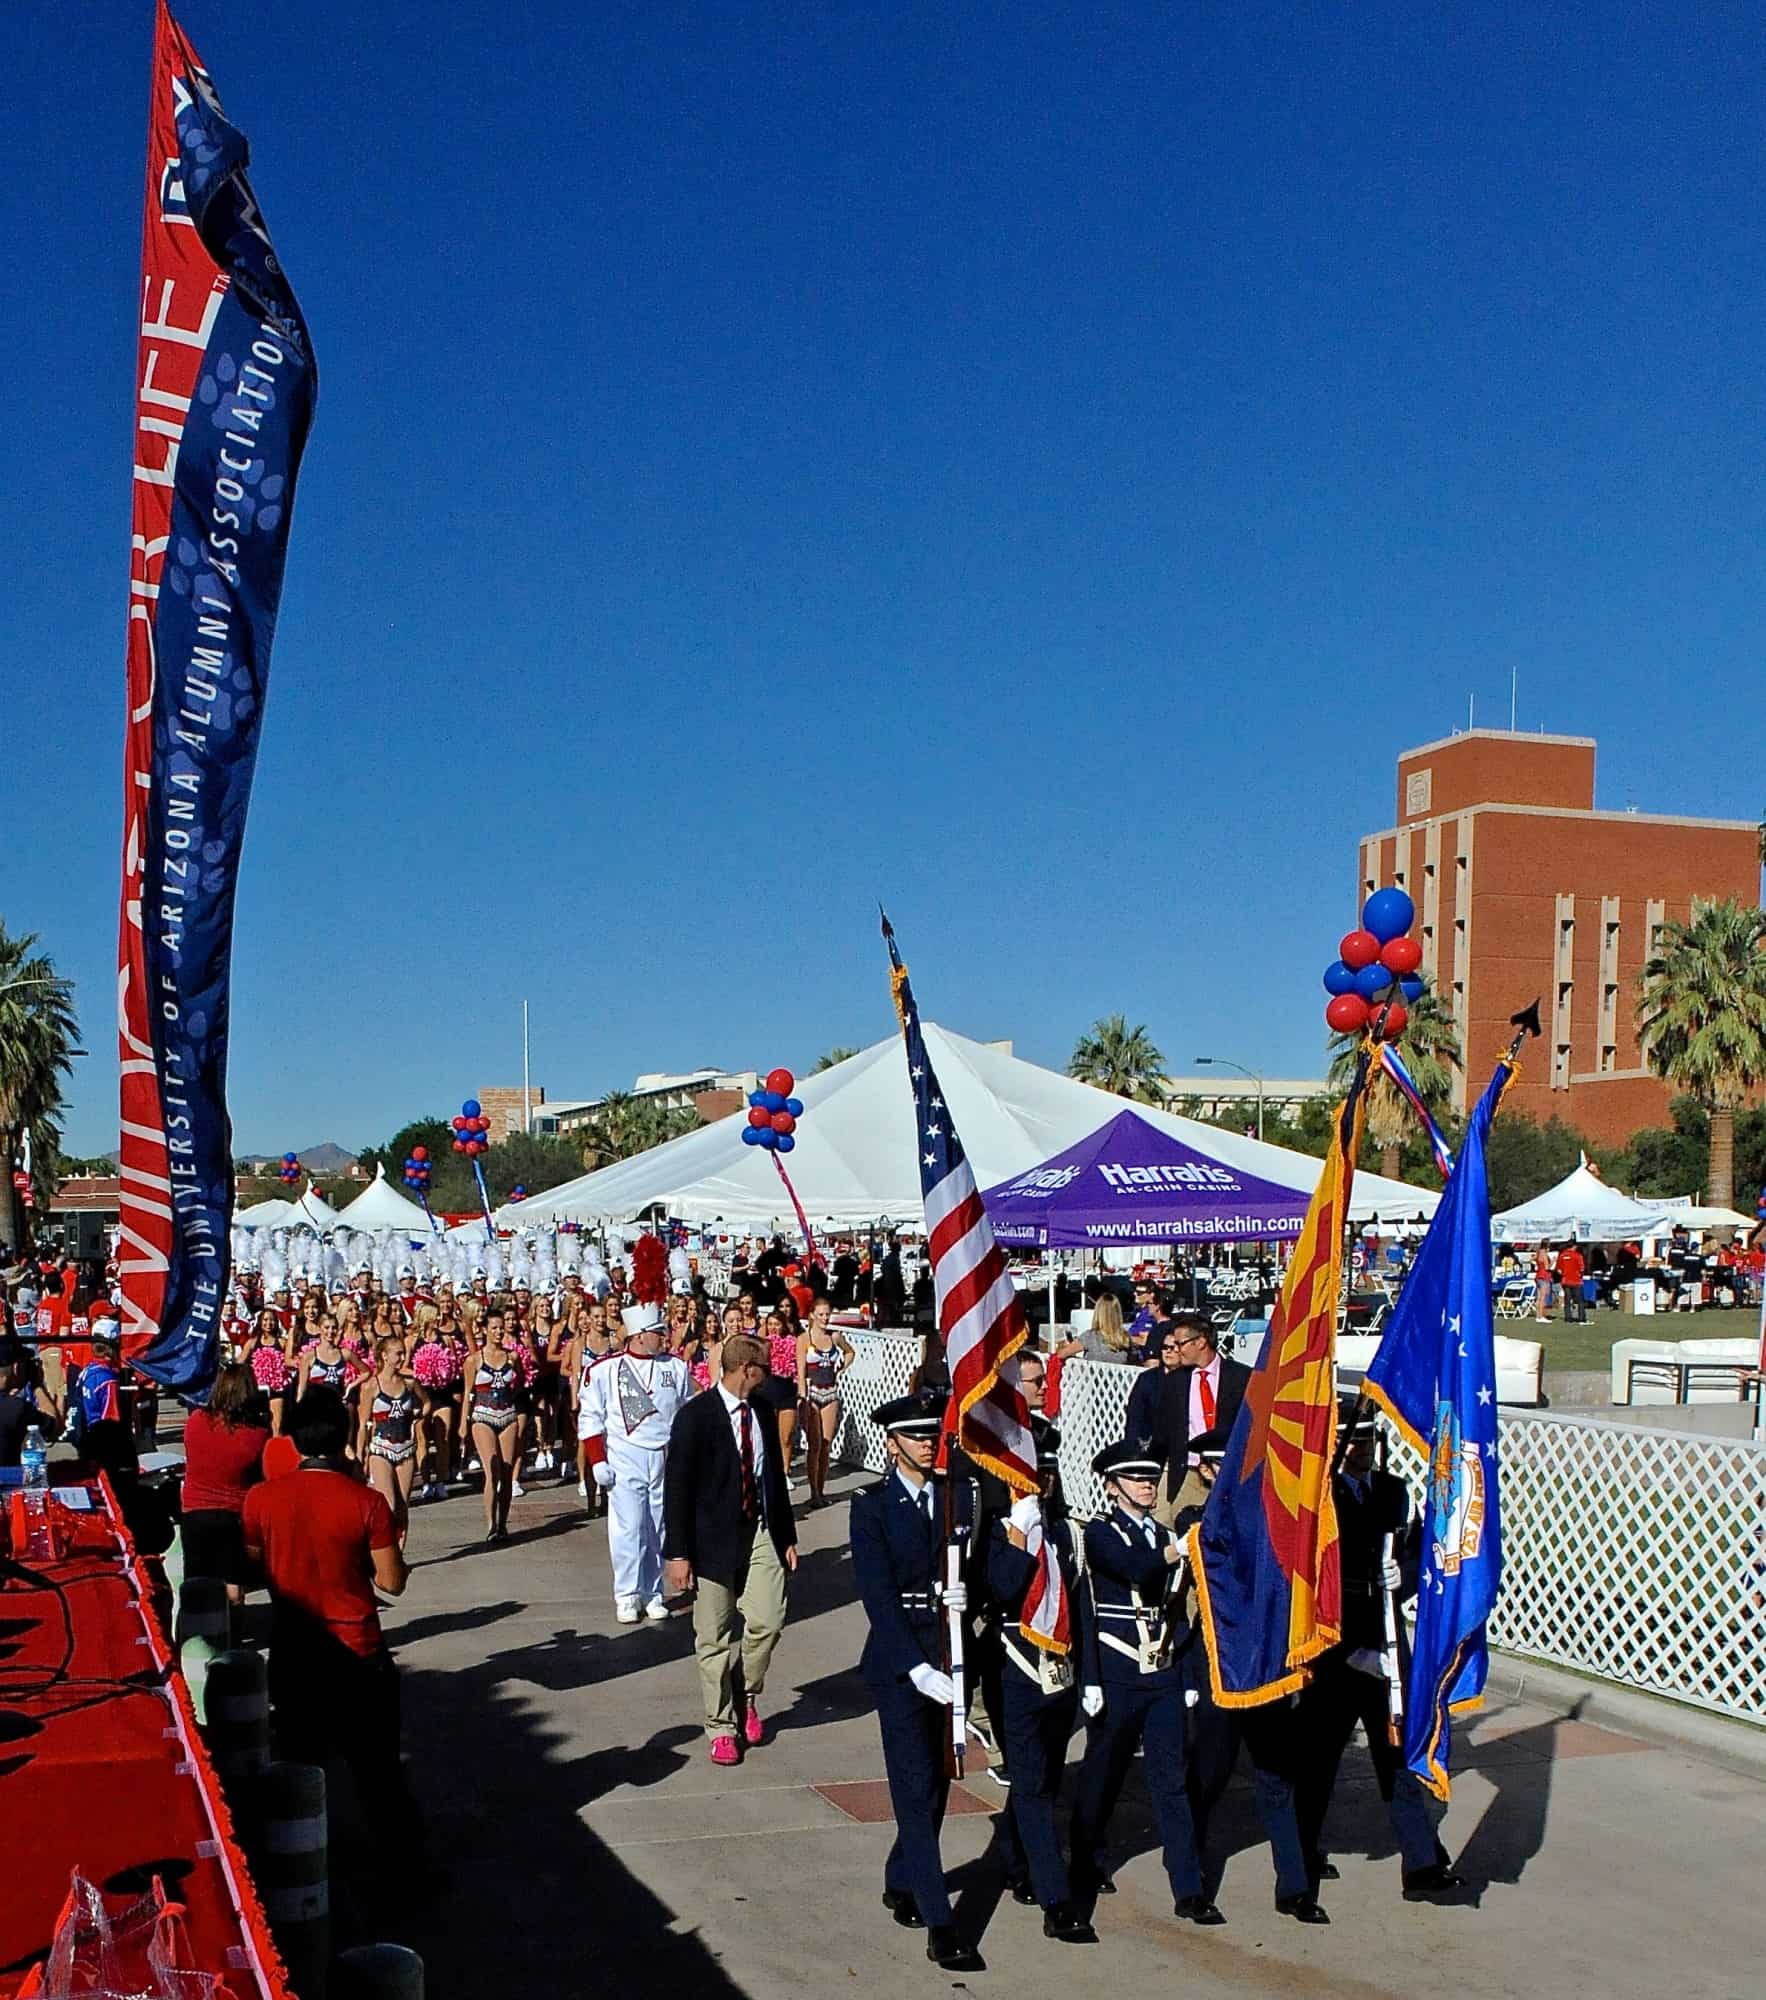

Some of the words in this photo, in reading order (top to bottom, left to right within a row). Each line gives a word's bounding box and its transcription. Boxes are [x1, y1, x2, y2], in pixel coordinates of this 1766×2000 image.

[176, 596, 232, 752] ALUMNI
[161, 774, 200, 951] ARIZONA
[161, 976, 179, 1021] OF
[164, 1047, 217, 1258] UNIVERSITY
[1117, 1184, 1182, 1194] AK-CHIN
[1189, 1182, 1242, 1192] CASINO
[1086, 1216, 1304, 1237] www.harrahsakchin.com
[185, 1280, 217, 1341] THE
